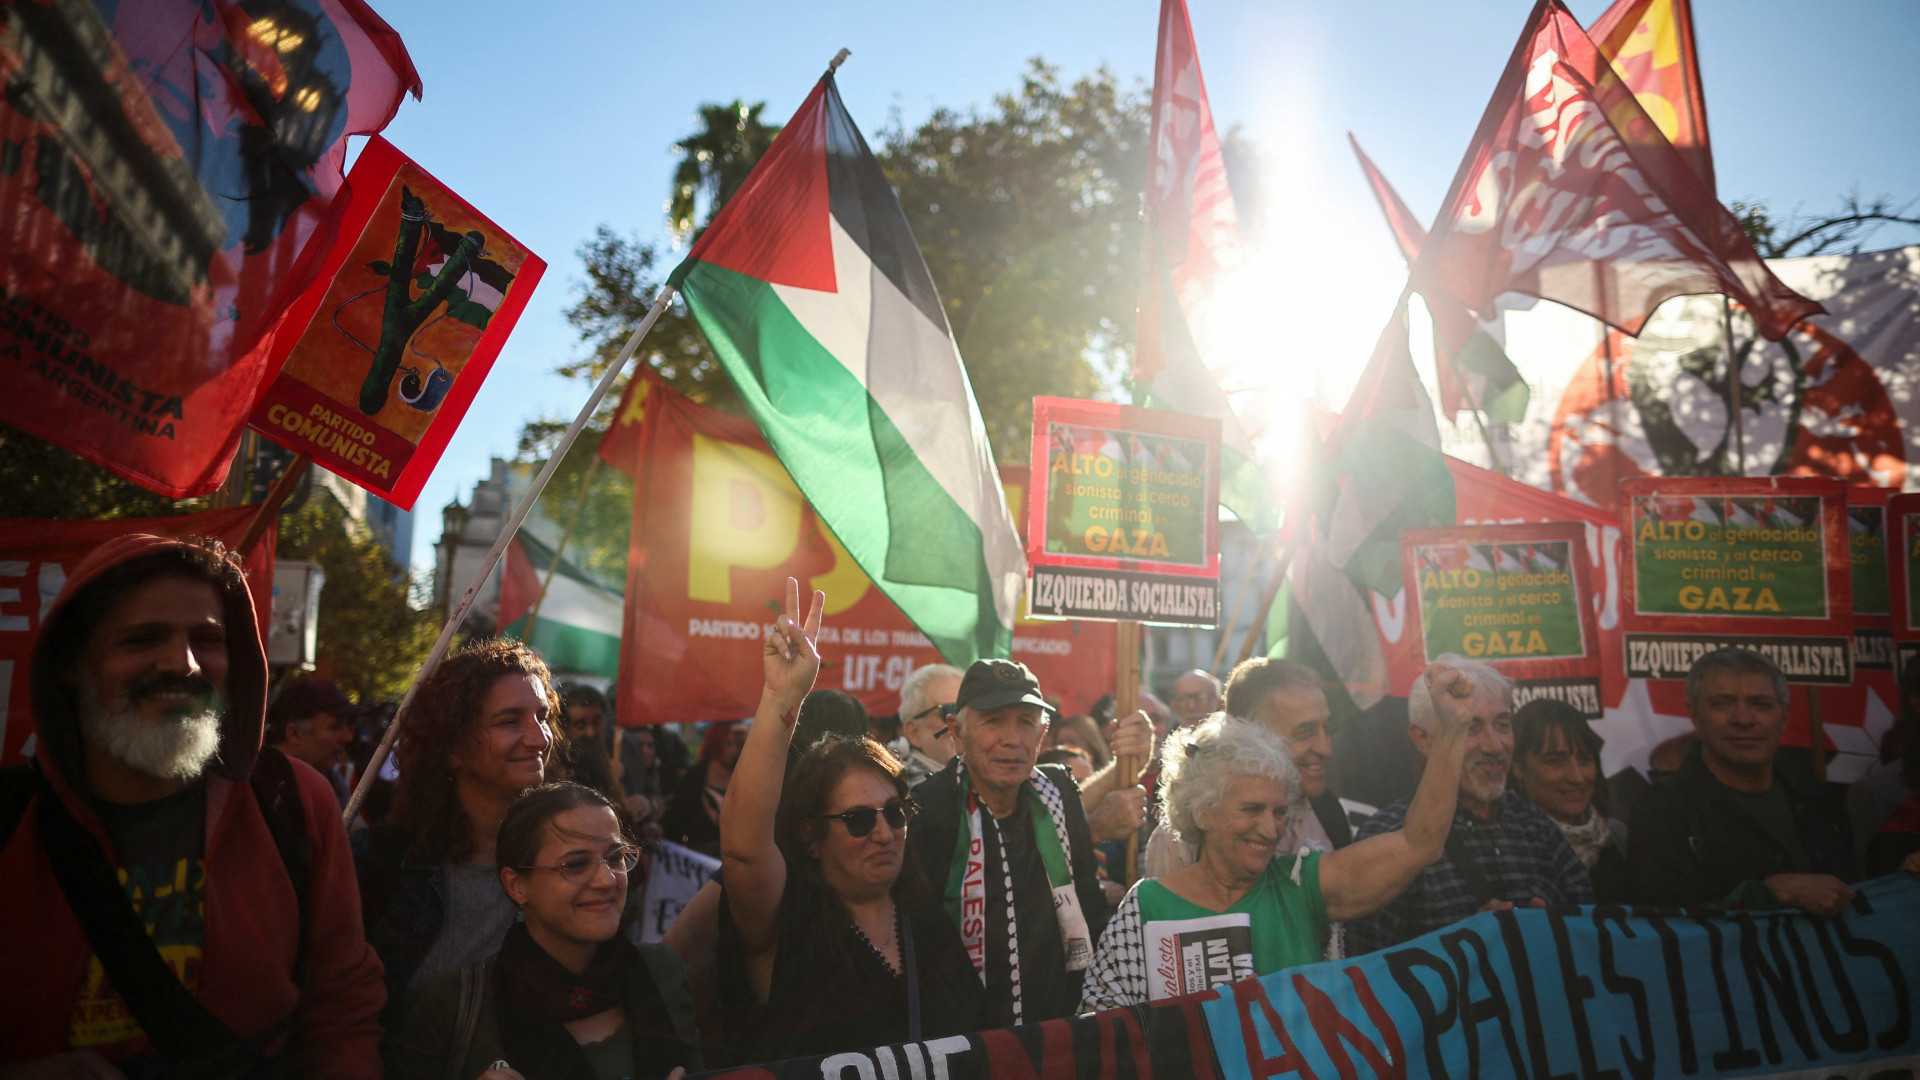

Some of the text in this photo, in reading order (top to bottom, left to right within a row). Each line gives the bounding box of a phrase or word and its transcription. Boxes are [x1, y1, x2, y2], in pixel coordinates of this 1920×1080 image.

[30, 359, 175, 440] ARGENTINA
[309, 403, 376, 446] PARTIDO
[267, 404, 391, 480] COMUNISTA
[1052, 452, 1113, 478] ALTO
[1130, 466, 1202, 488] genocidio
[1065, 483, 1190, 508] sionista y al cerco
[1089, 504, 1168, 526] criminal en
[1084, 525, 1170, 558] GAZA
[1639, 520, 1705, 541] ALTO
[1725, 525, 1818, 545] genocidio
[1654, 547, 1803, 562] sionista y al cerco
[1423, 569, 1480, 590] ALTO
[1497, 570, 1569, 591] genocidio
[1682, 564, 1776, 582] criminal en
[1035, 573, 1216, 618] IZQUIERDA SOCIALISTA
[1438, 594, 1493, 608] sionista
[1519, 592, 1560, 606] cerco
[1678, 585, 1781, 612] GAZA
[690, 618, 759, 640] PARTIDO
[1464, 608, 1542, 626] criminal en
[1462, 630, 1548, 657] GAZA
[1629, 641, 1728, 679] IZQUIER
[1194, 955, 1205, 991] ilei-FMI
[1384, 891, 1911, 1080] PALESTINOS
